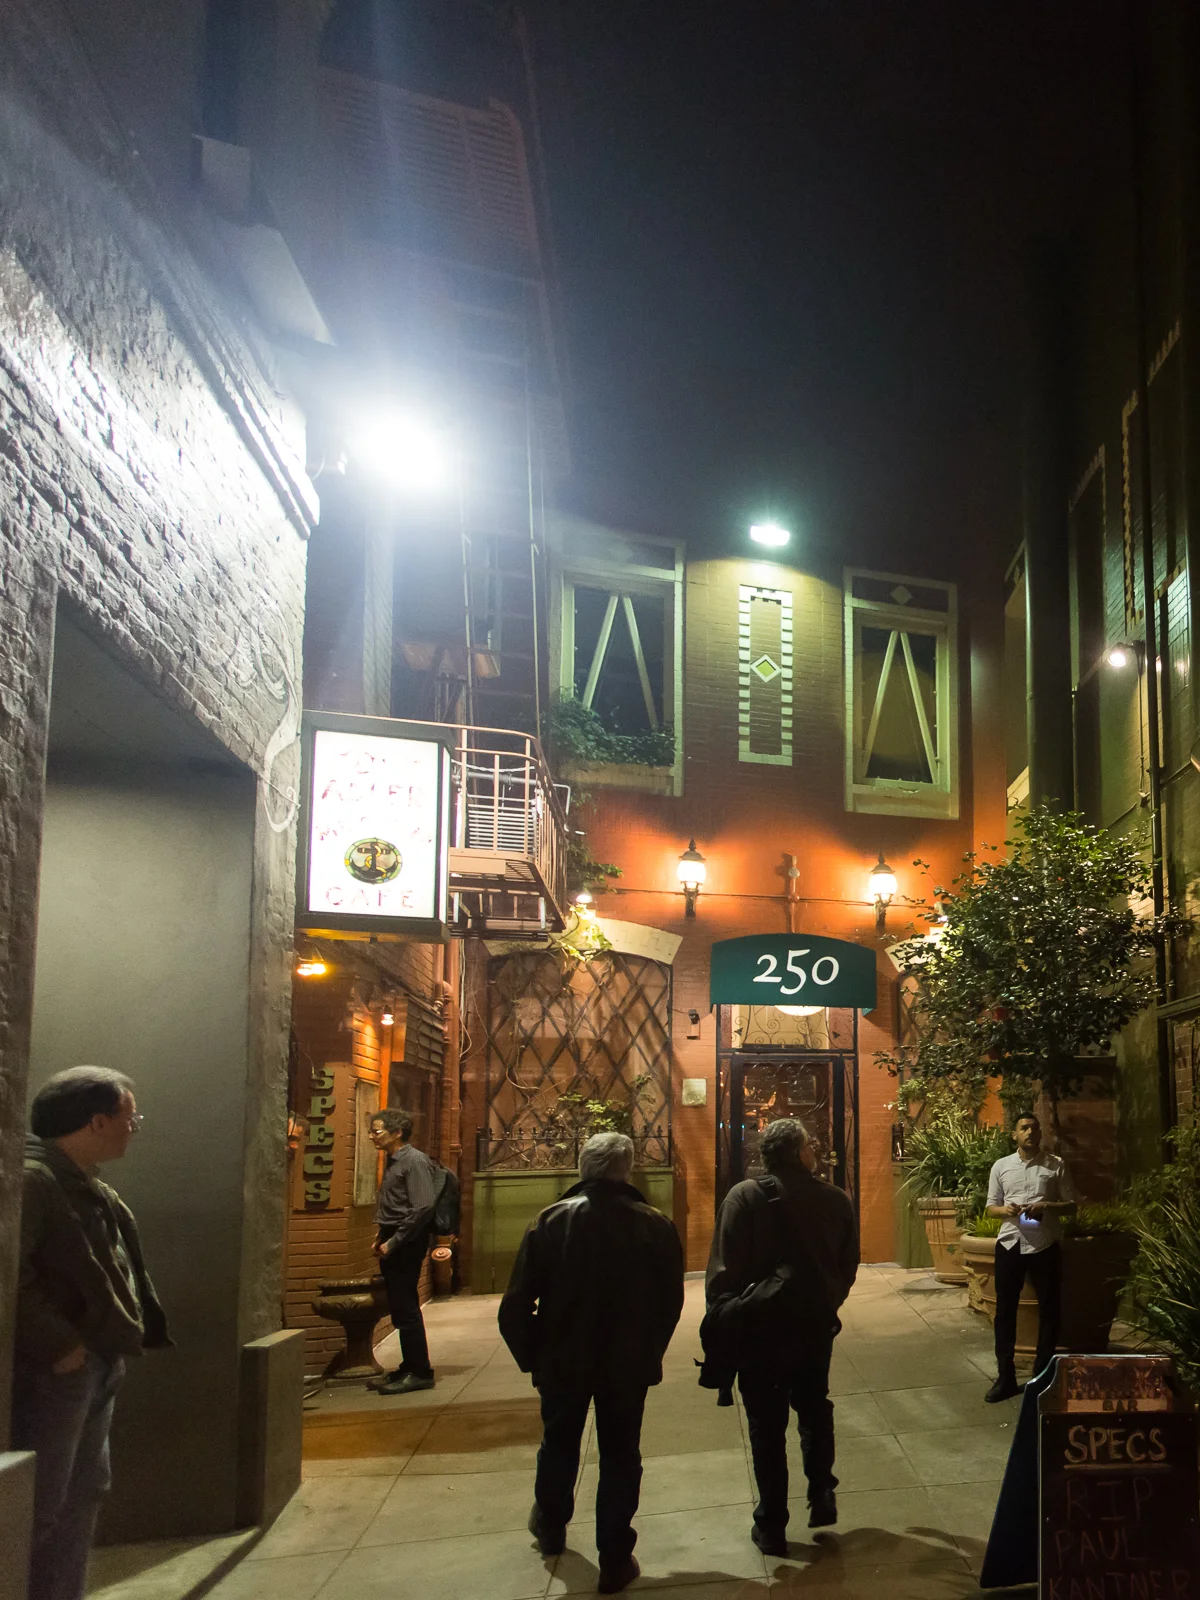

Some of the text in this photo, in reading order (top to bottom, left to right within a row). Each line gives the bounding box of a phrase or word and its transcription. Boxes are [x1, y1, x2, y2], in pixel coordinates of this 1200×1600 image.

[325, 885, 414, 908] CAFE
[752, 948, 840, 995] 250
[304, 1066, 335, 1203] SPECS
[1064, 1425, 1168, 1464] SPECS
[1054, 1529, 1148, 1569] PAUL
[1049, 1570, 1192, 1600] KANTNER
